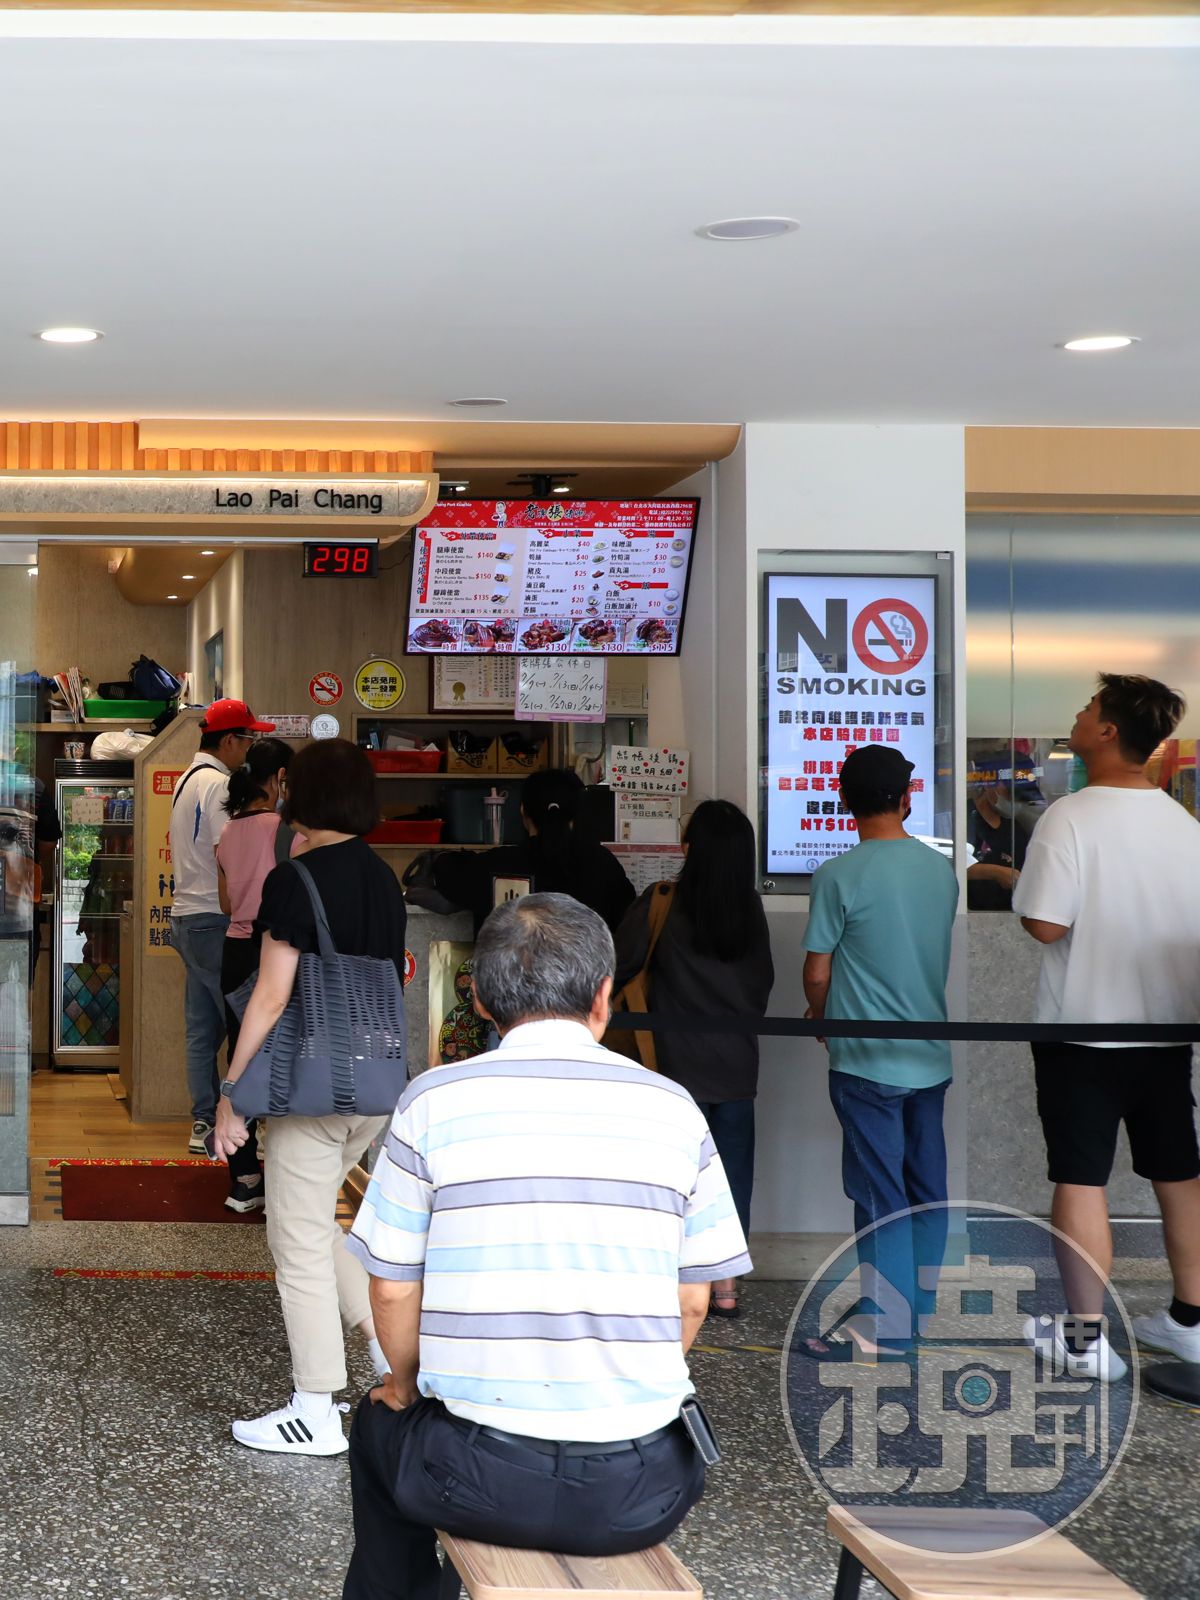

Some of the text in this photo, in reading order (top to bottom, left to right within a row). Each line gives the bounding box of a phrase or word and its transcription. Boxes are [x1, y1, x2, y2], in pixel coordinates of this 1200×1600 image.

[215, 488, 383, 513] Lao Pai Chang
[477, 551, 493, 559] $140
[312, 547, 369, 573] 298
[605, 590, 620, 598] 白飯
[648, 600, 661, 608] $10
[545, 643, 568, 652] $130
[601, 643, 623, 652] $130
[651, 643, 673, 652] $115
[361, 676, 398, 685] 本店免用
[361, 685, 398, 693] 統一發票
[777, 677, 926, 696] SMOKING
[806, 801, 851, 815] 違者最
